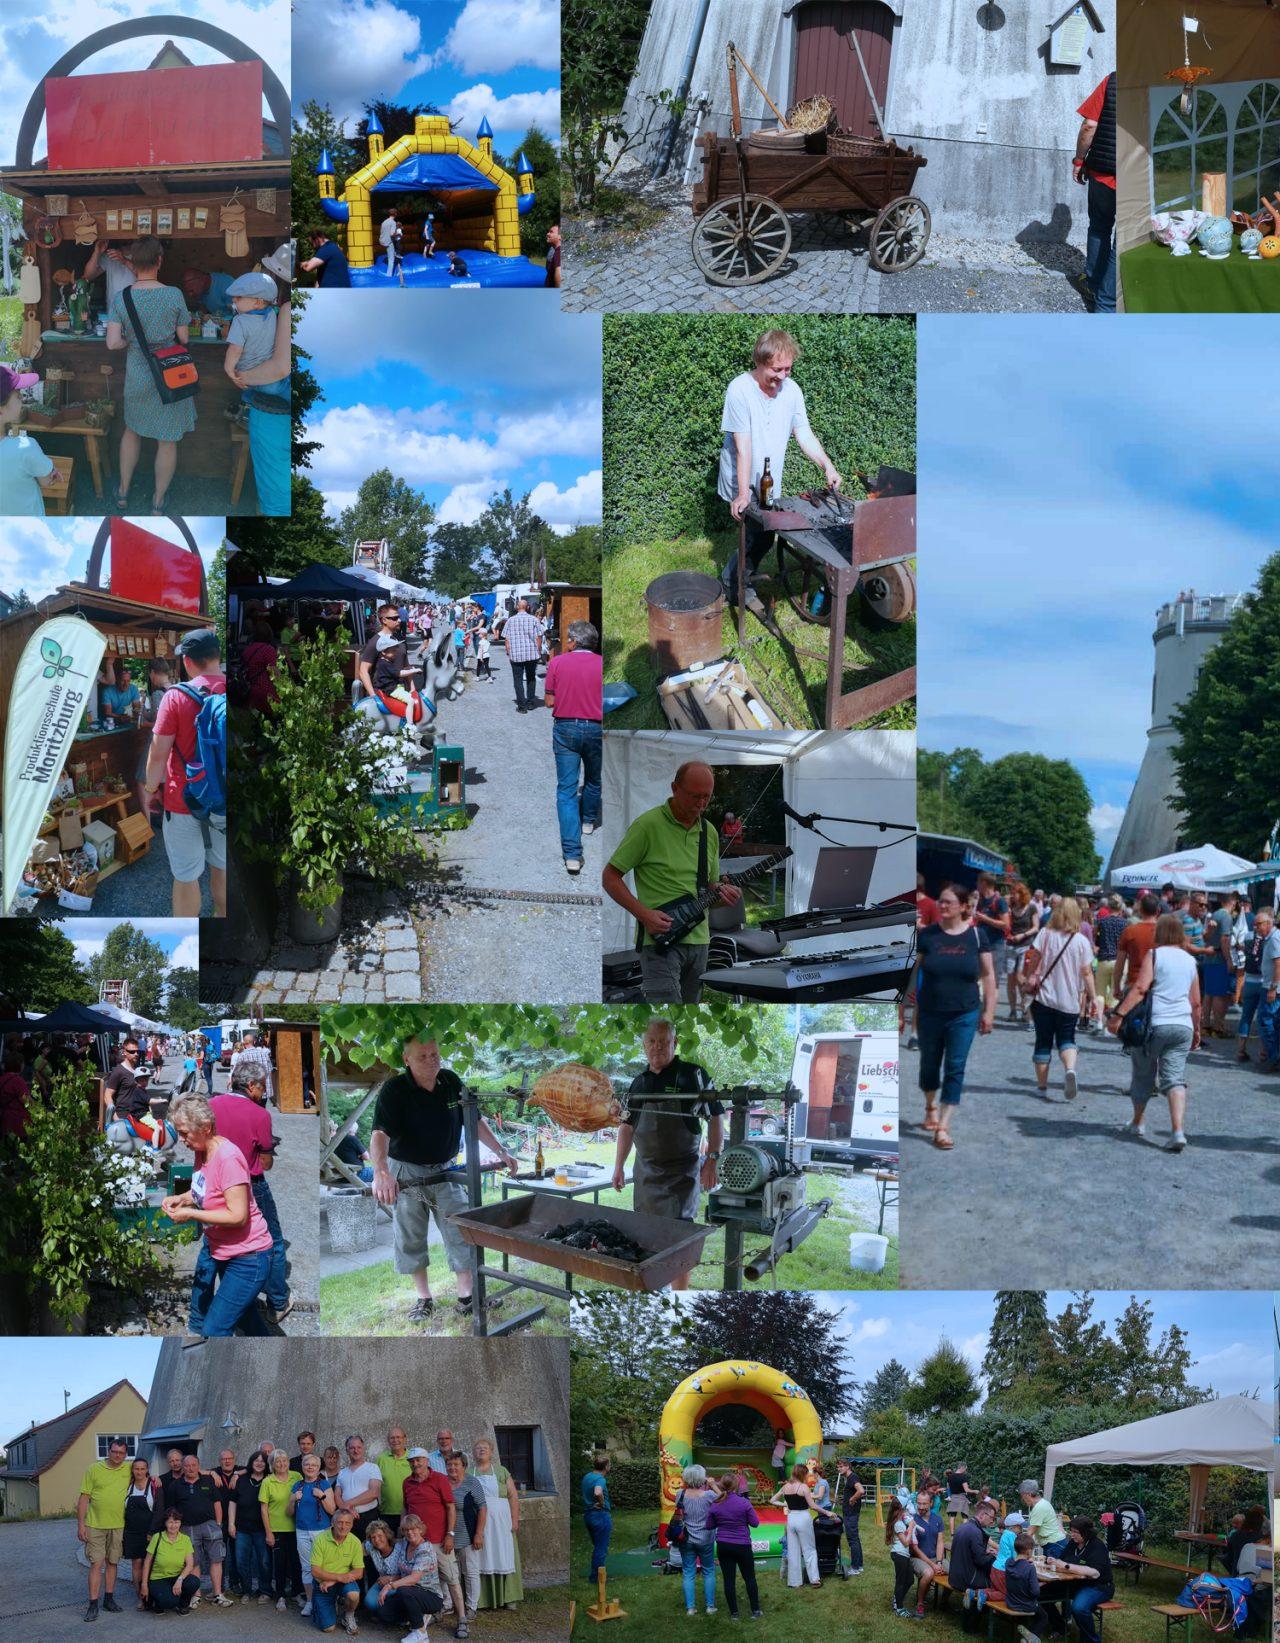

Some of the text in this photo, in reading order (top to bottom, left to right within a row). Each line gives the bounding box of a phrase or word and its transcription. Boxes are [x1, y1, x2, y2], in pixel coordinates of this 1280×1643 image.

[19, 685, 63, 781] Produktionsschule
[31, 688, 84, 784] Moritzburg
[1121, 874, 1159, 883] ERDINGER
